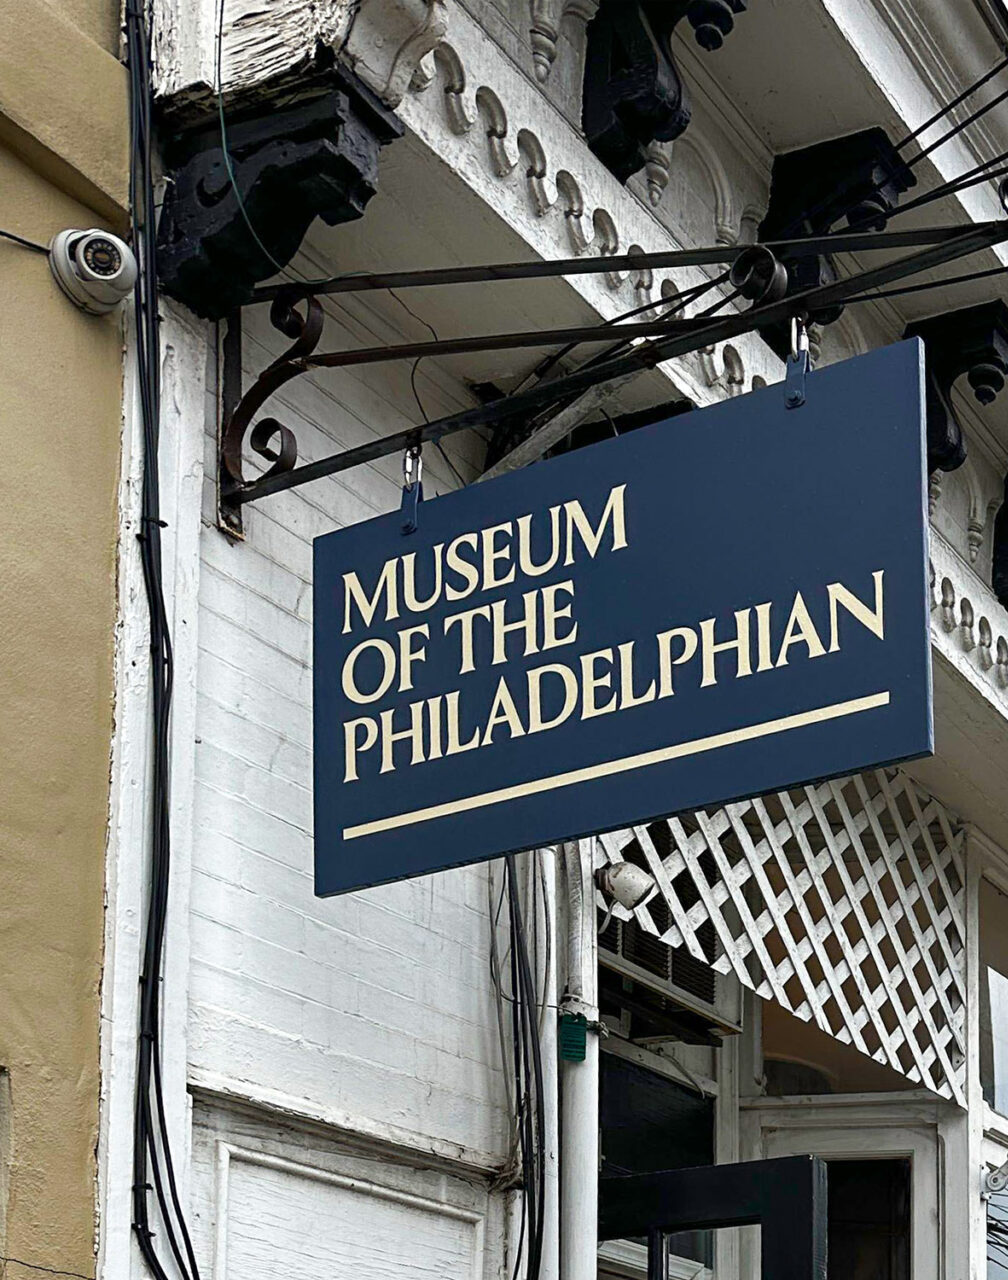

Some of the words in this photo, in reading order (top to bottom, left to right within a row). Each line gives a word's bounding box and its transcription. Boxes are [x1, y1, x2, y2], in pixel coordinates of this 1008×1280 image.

[341, 484, 628, 635] MUSEUM
[342, 623, 430, 706] OF
[443, 580, 579, 676] THE
[342, 569, 885, 784] PHILADELPHIAN
